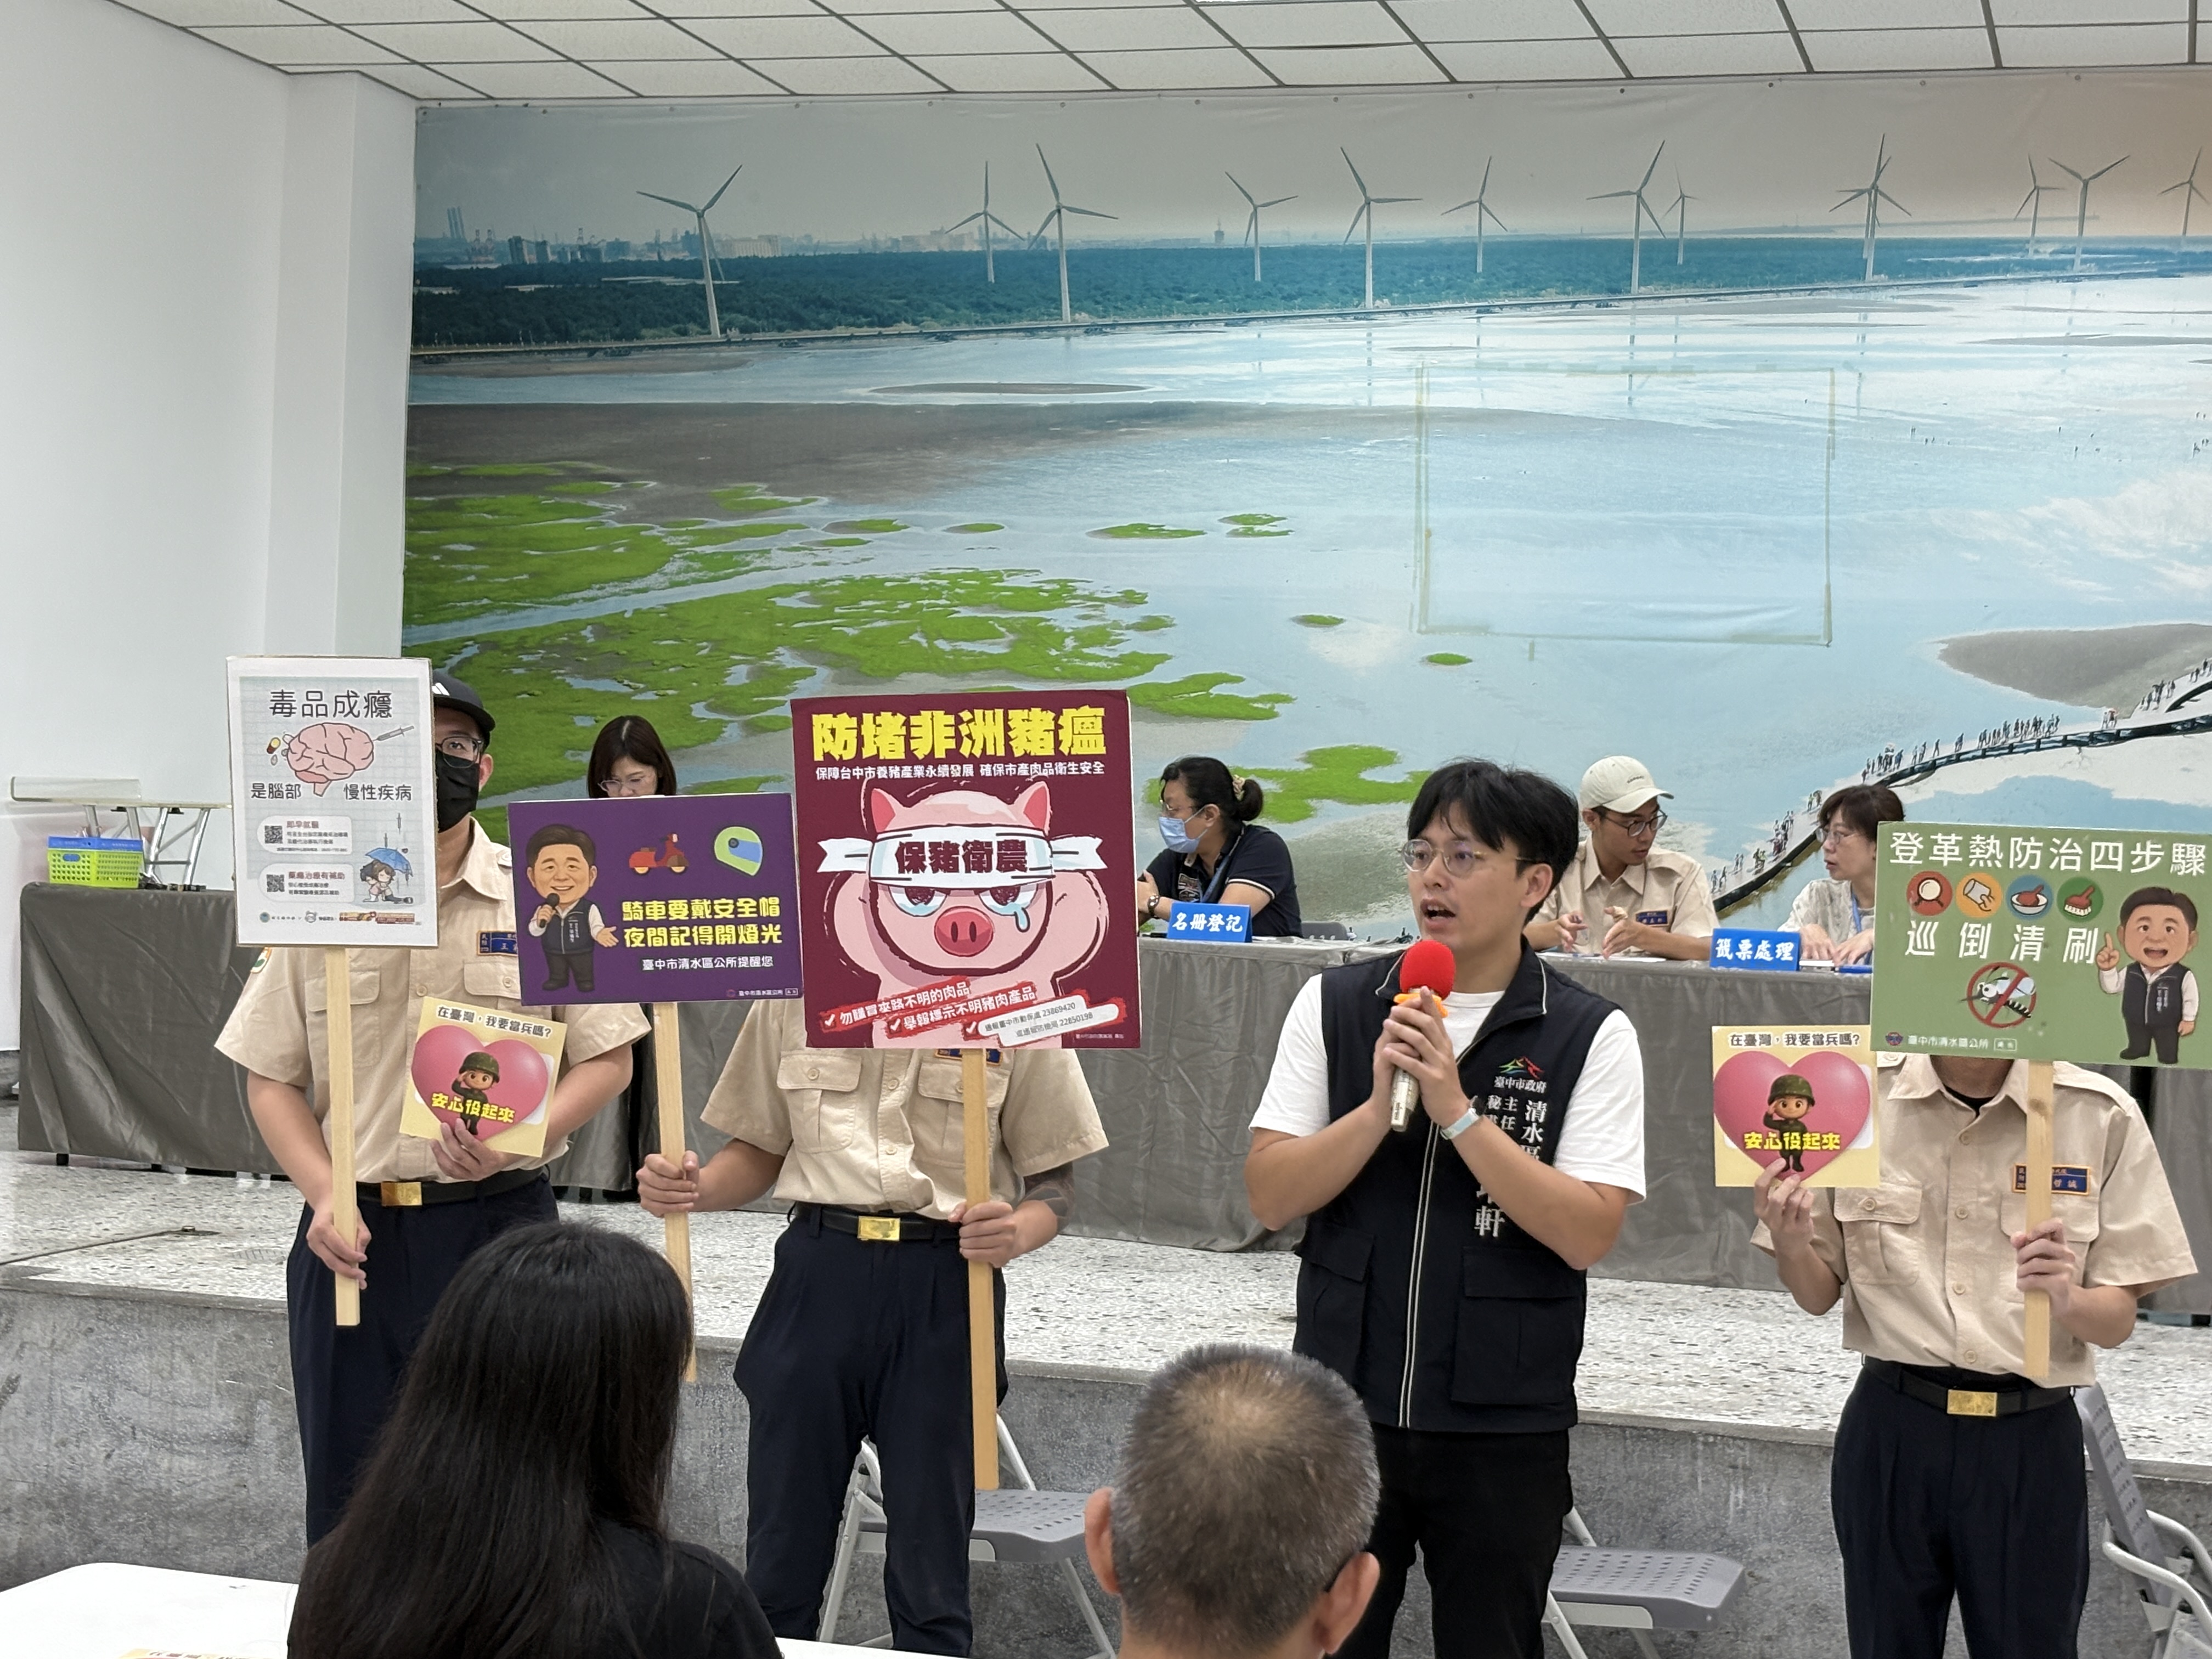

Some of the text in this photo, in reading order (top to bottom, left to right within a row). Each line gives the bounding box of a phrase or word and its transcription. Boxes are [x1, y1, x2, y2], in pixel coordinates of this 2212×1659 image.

[269, 689, 392, 718] 毒品成癮
[812, 705, 1106, 761] 防堵非洲豬瘟
[816, 760, 1104, 781] 保障台中市養豬產業永續發展 確保市產肉品衛生安全
[251, 782, 412, 801] 是腦部 慢性疾病
[895, 839, 1029, 874] 保豬衛農
[1889, 832, 2206, 876] 登革熱防治四步驟
[622, 896, 781, 922] 騎車要戴安全帽
[1172, 911, 1243, 932] 名冊登記
[623, 923, 783, 948] 夜間記得開燈光
[642, 955, 774, 970] 臺中市清水區公所提醒您
[1059, 1012, 1093, 1027] 22850198
[1493, 1076, 1547, 1093] 臺中市政府
[431, 1093, 515, 1123] 安心役起來
[1743, 1132, 1841, 1150] 安心役起來
